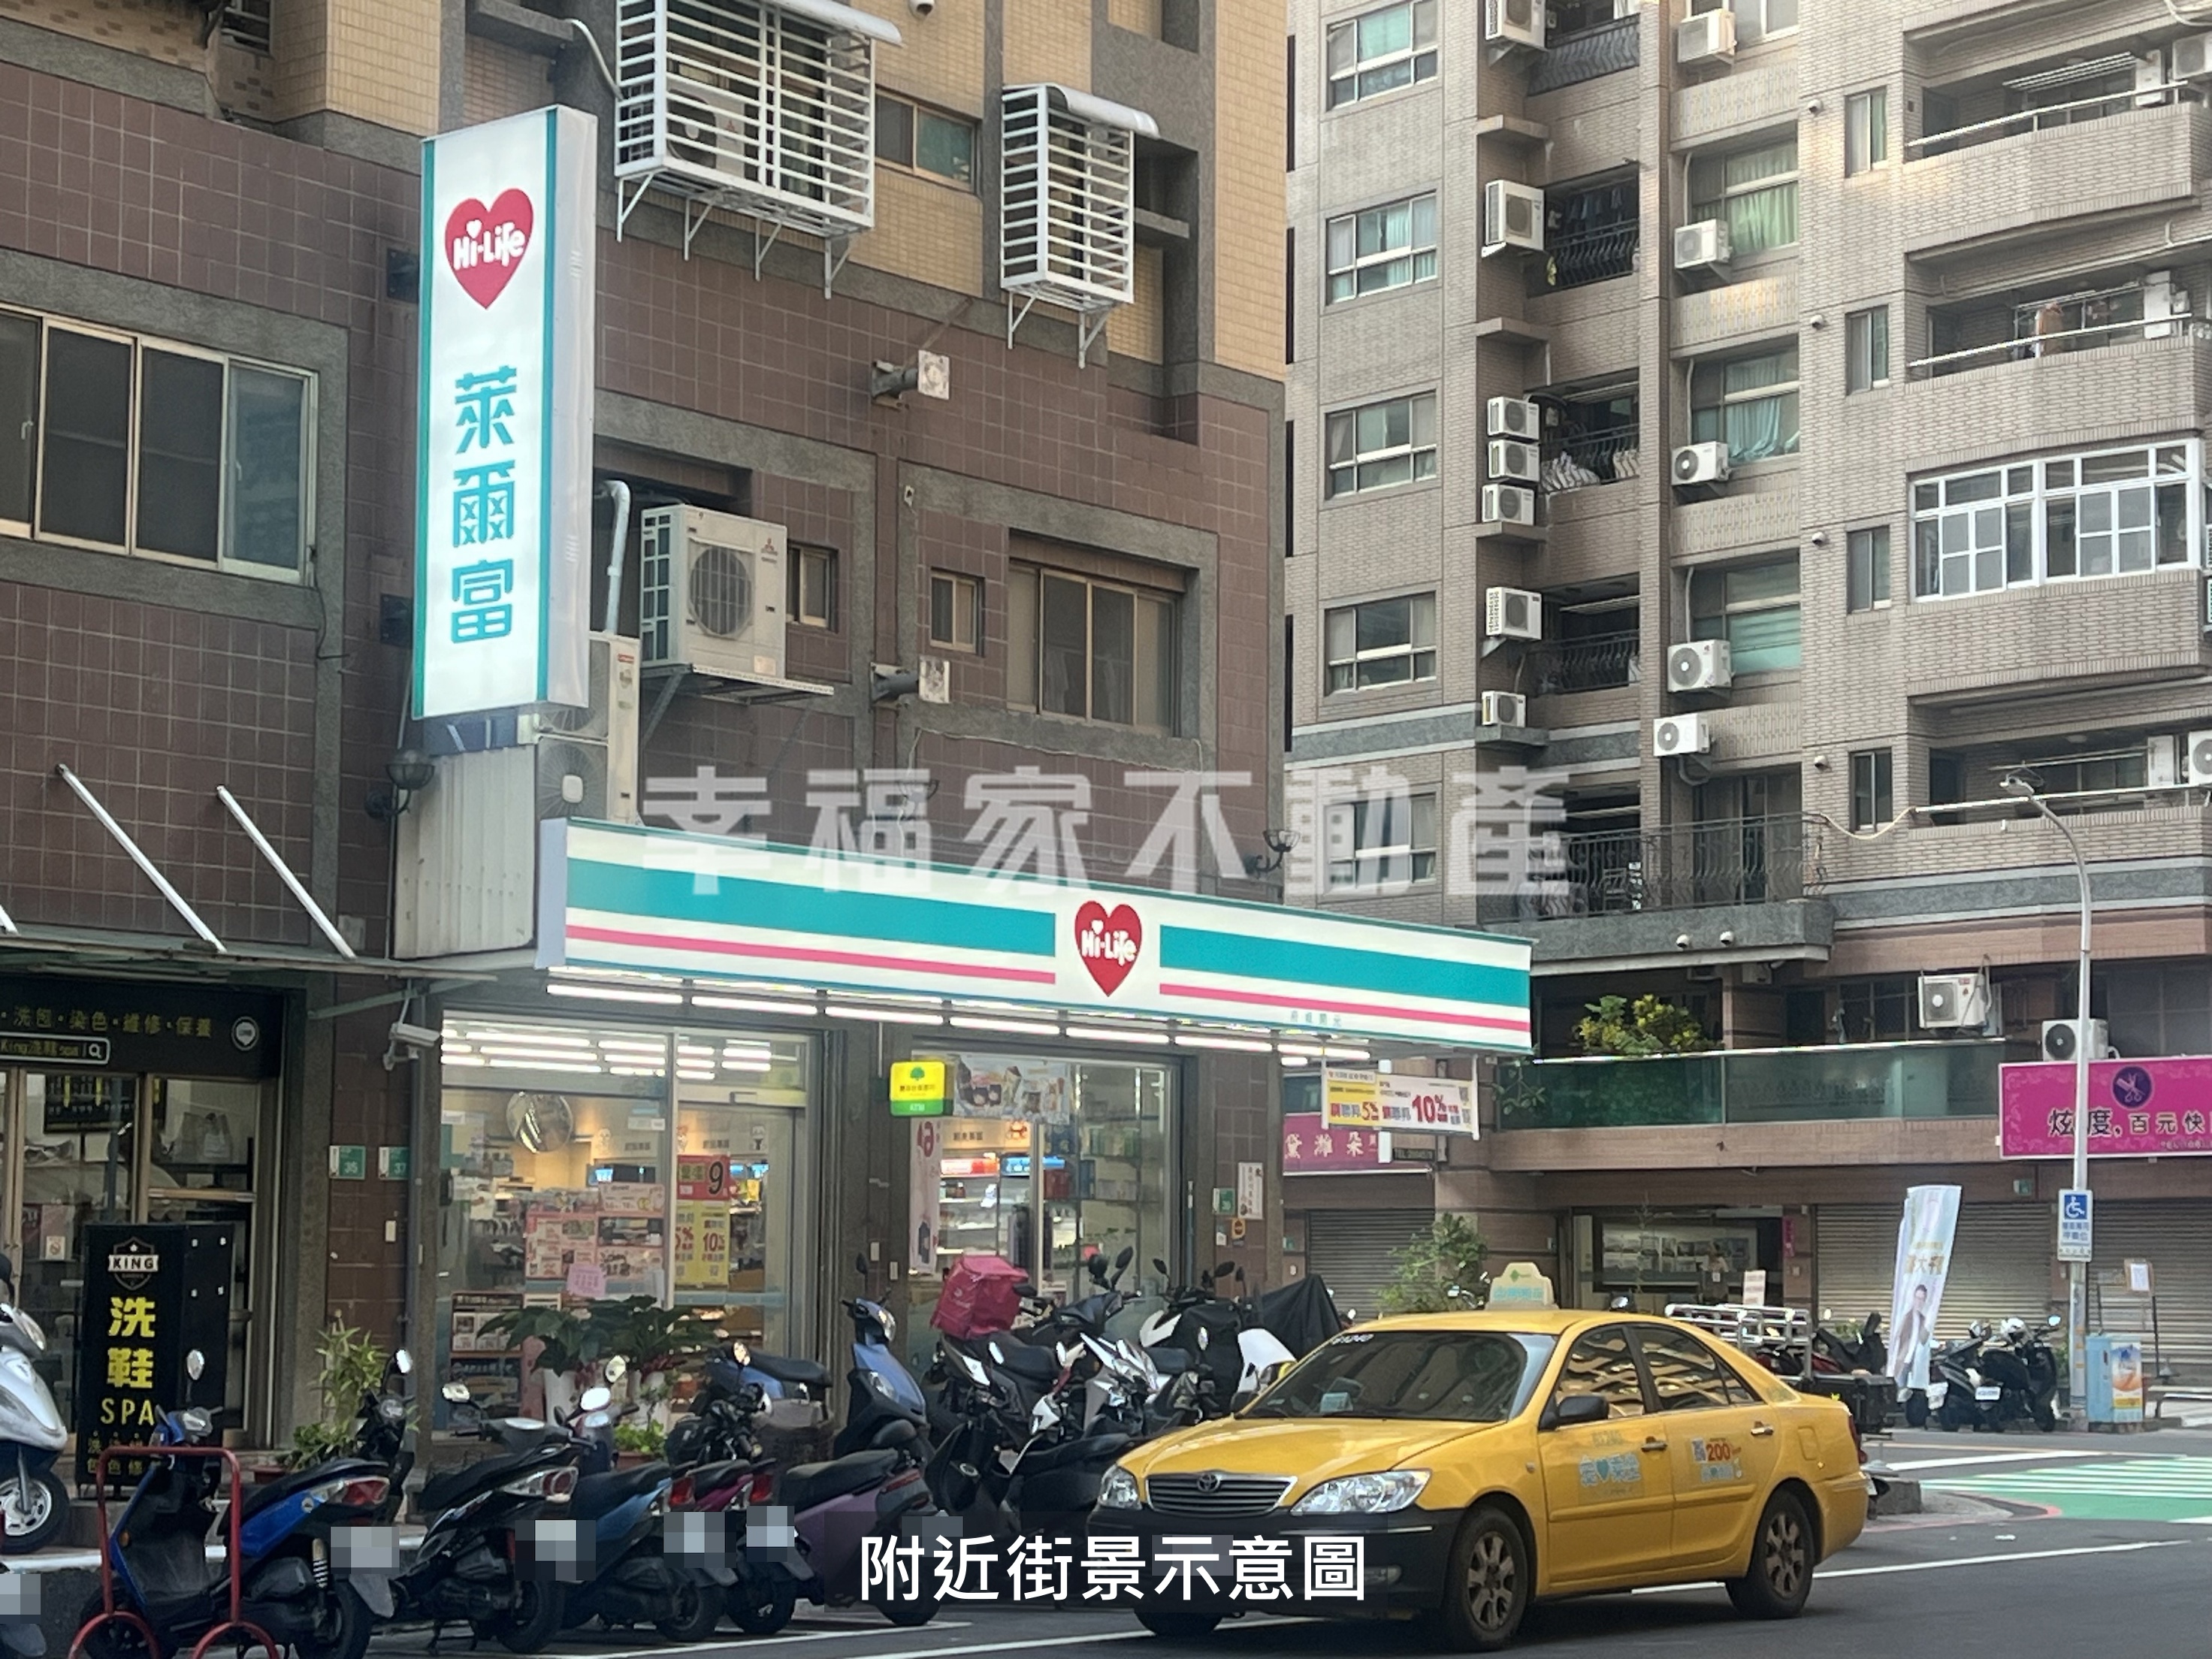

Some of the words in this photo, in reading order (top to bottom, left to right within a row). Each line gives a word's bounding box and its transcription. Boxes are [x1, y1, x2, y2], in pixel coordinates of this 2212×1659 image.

[453, 219, 526, 270] Hi-Life
[451, 365, 517, 644] 萊爾富
[1081, 920, 1138, 966] Hi-Life
[113, 1256, 154, 1270] KING
[107, 1296, 156, 1389] 洗鞋
[100, 1398, 155, 1426] SPA
[1706, 1443, 1731, 1461] 200
